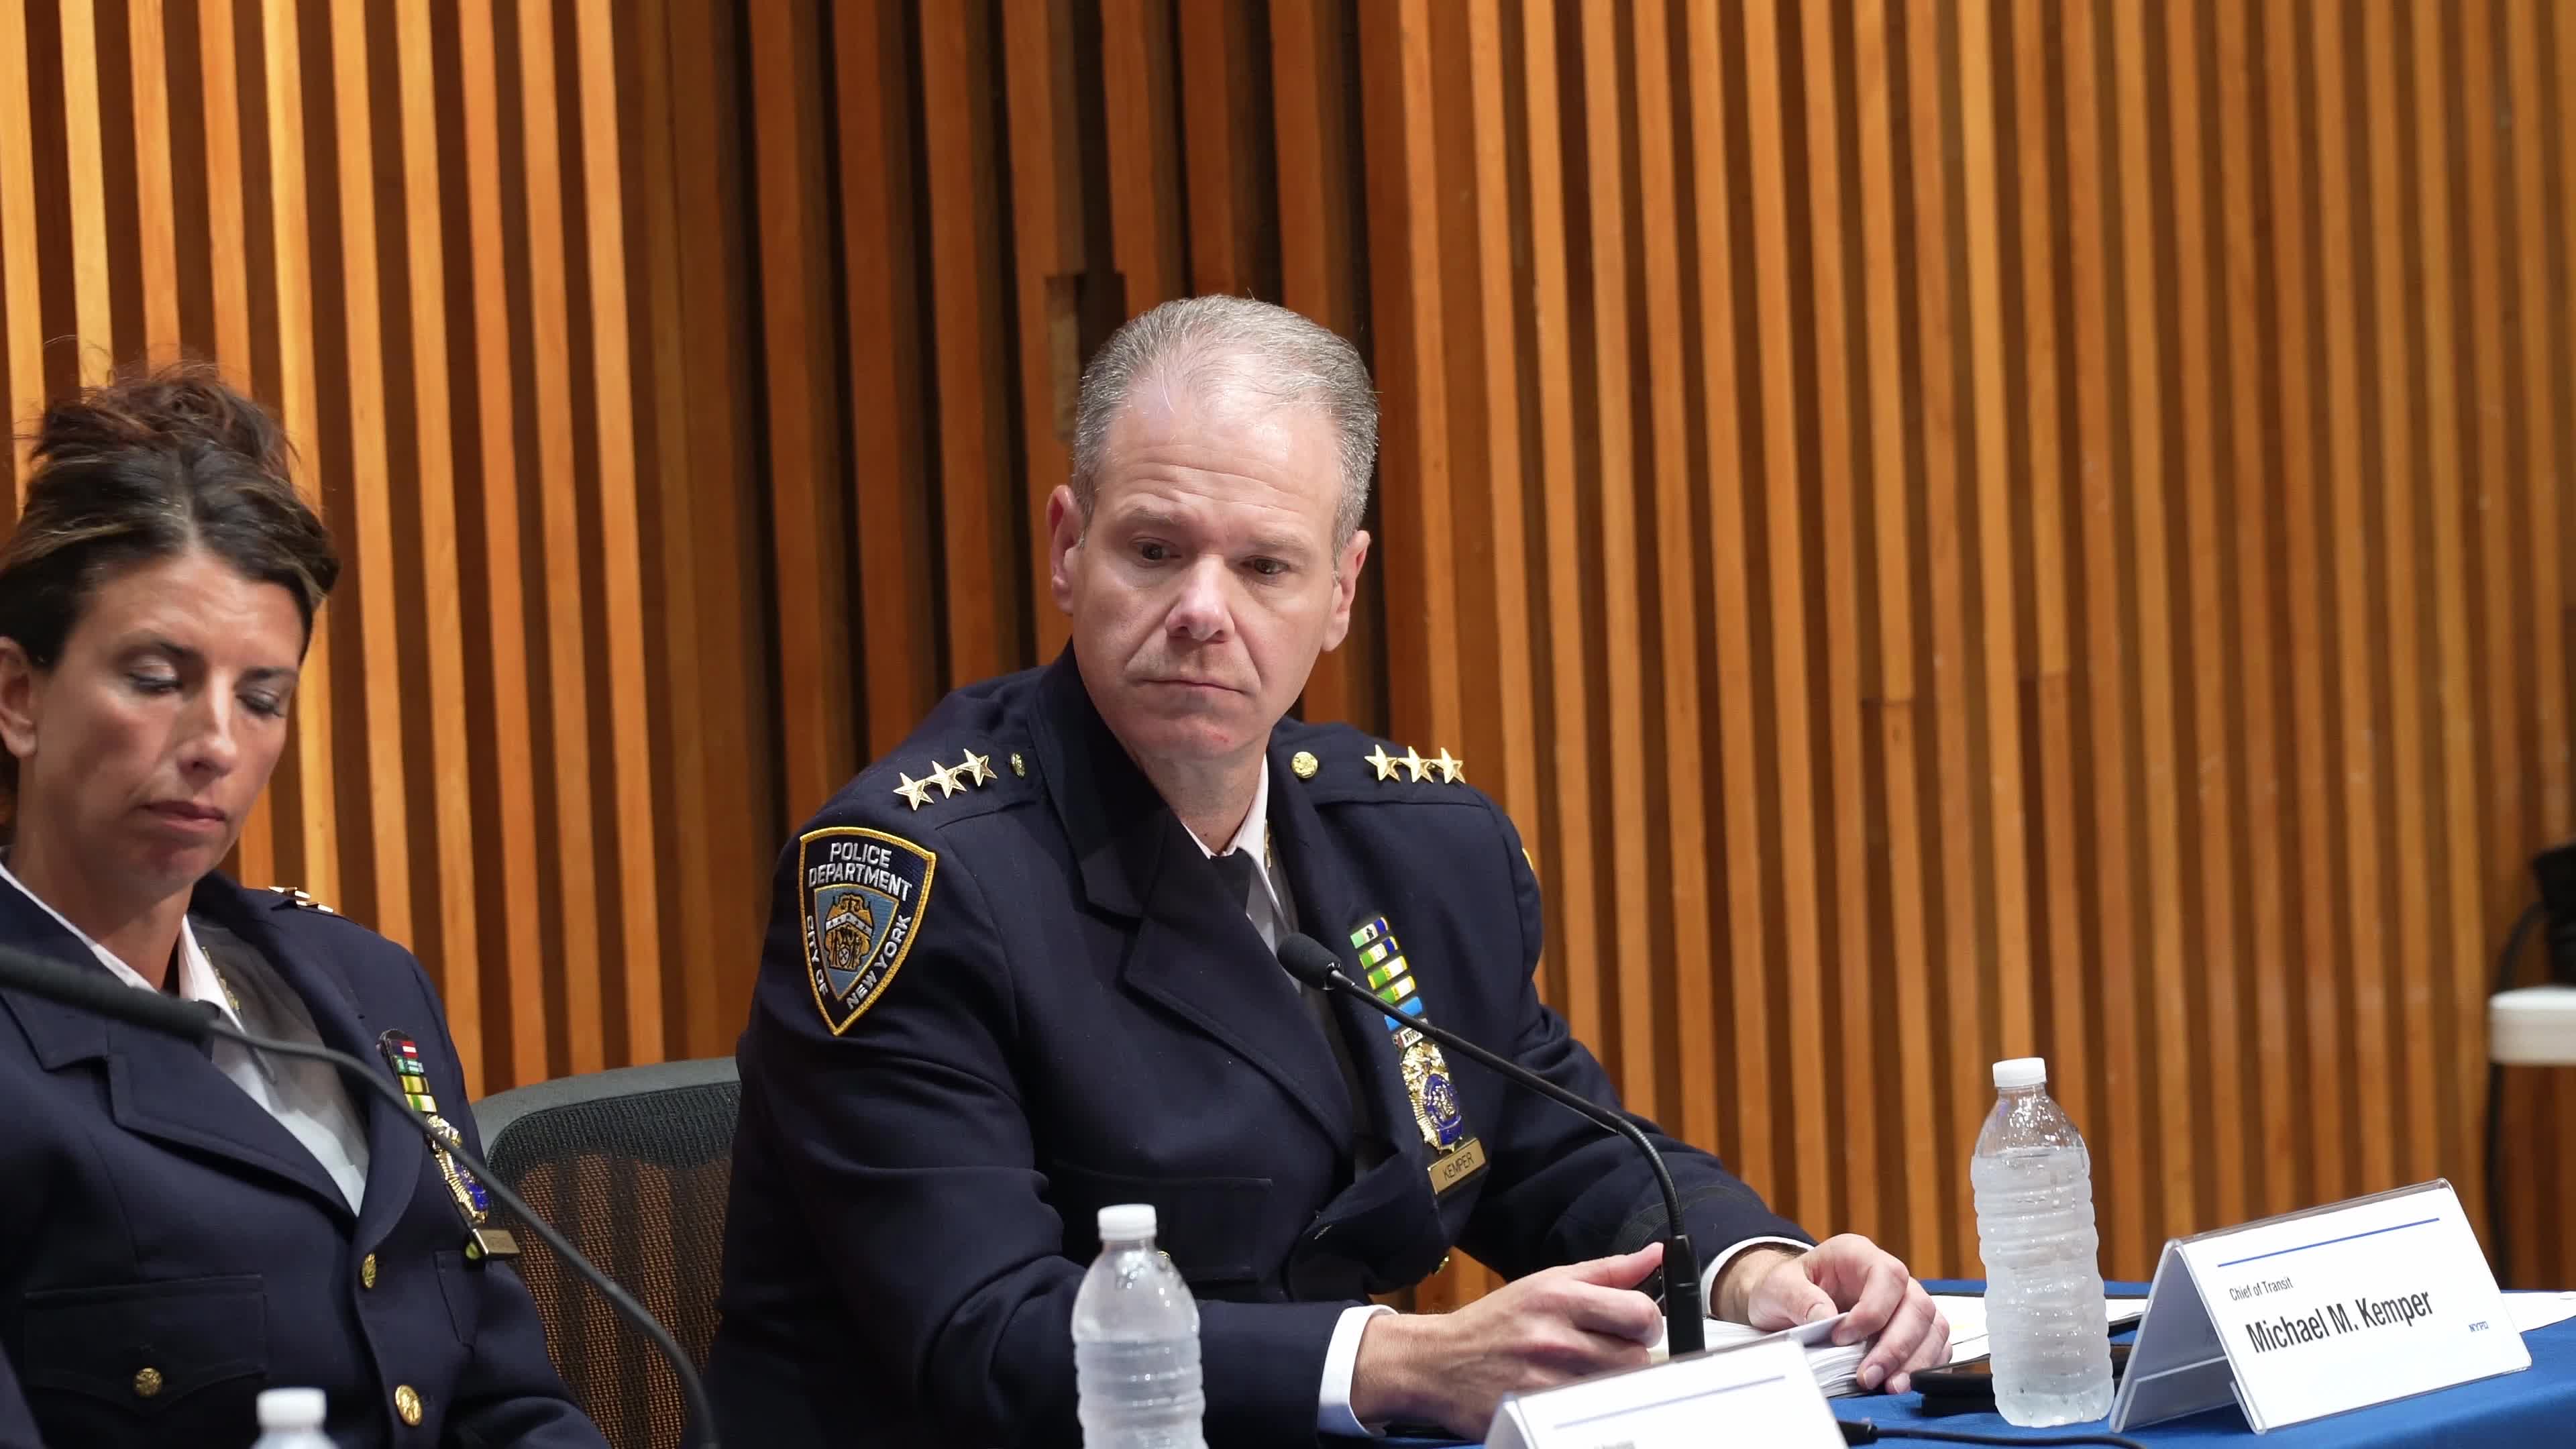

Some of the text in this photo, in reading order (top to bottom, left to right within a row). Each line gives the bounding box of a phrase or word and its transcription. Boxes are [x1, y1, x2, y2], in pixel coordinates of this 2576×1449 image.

[829, 842, 892, 869] POLICE
[808, 863, 913, 902] DEPARTMENT
[806, 915, 829, 996] CITY OF
[846, 914, 912, 1010] NEW YORK
[1442, 1151, 1475, 1181] KEMPER
[2229, 1275, 2294, 1301] Chief of Transit
[2245, 1291, 2433, 1354] Michael M. Kemper
[2468, 1320, 2489, 1333] NYPD
